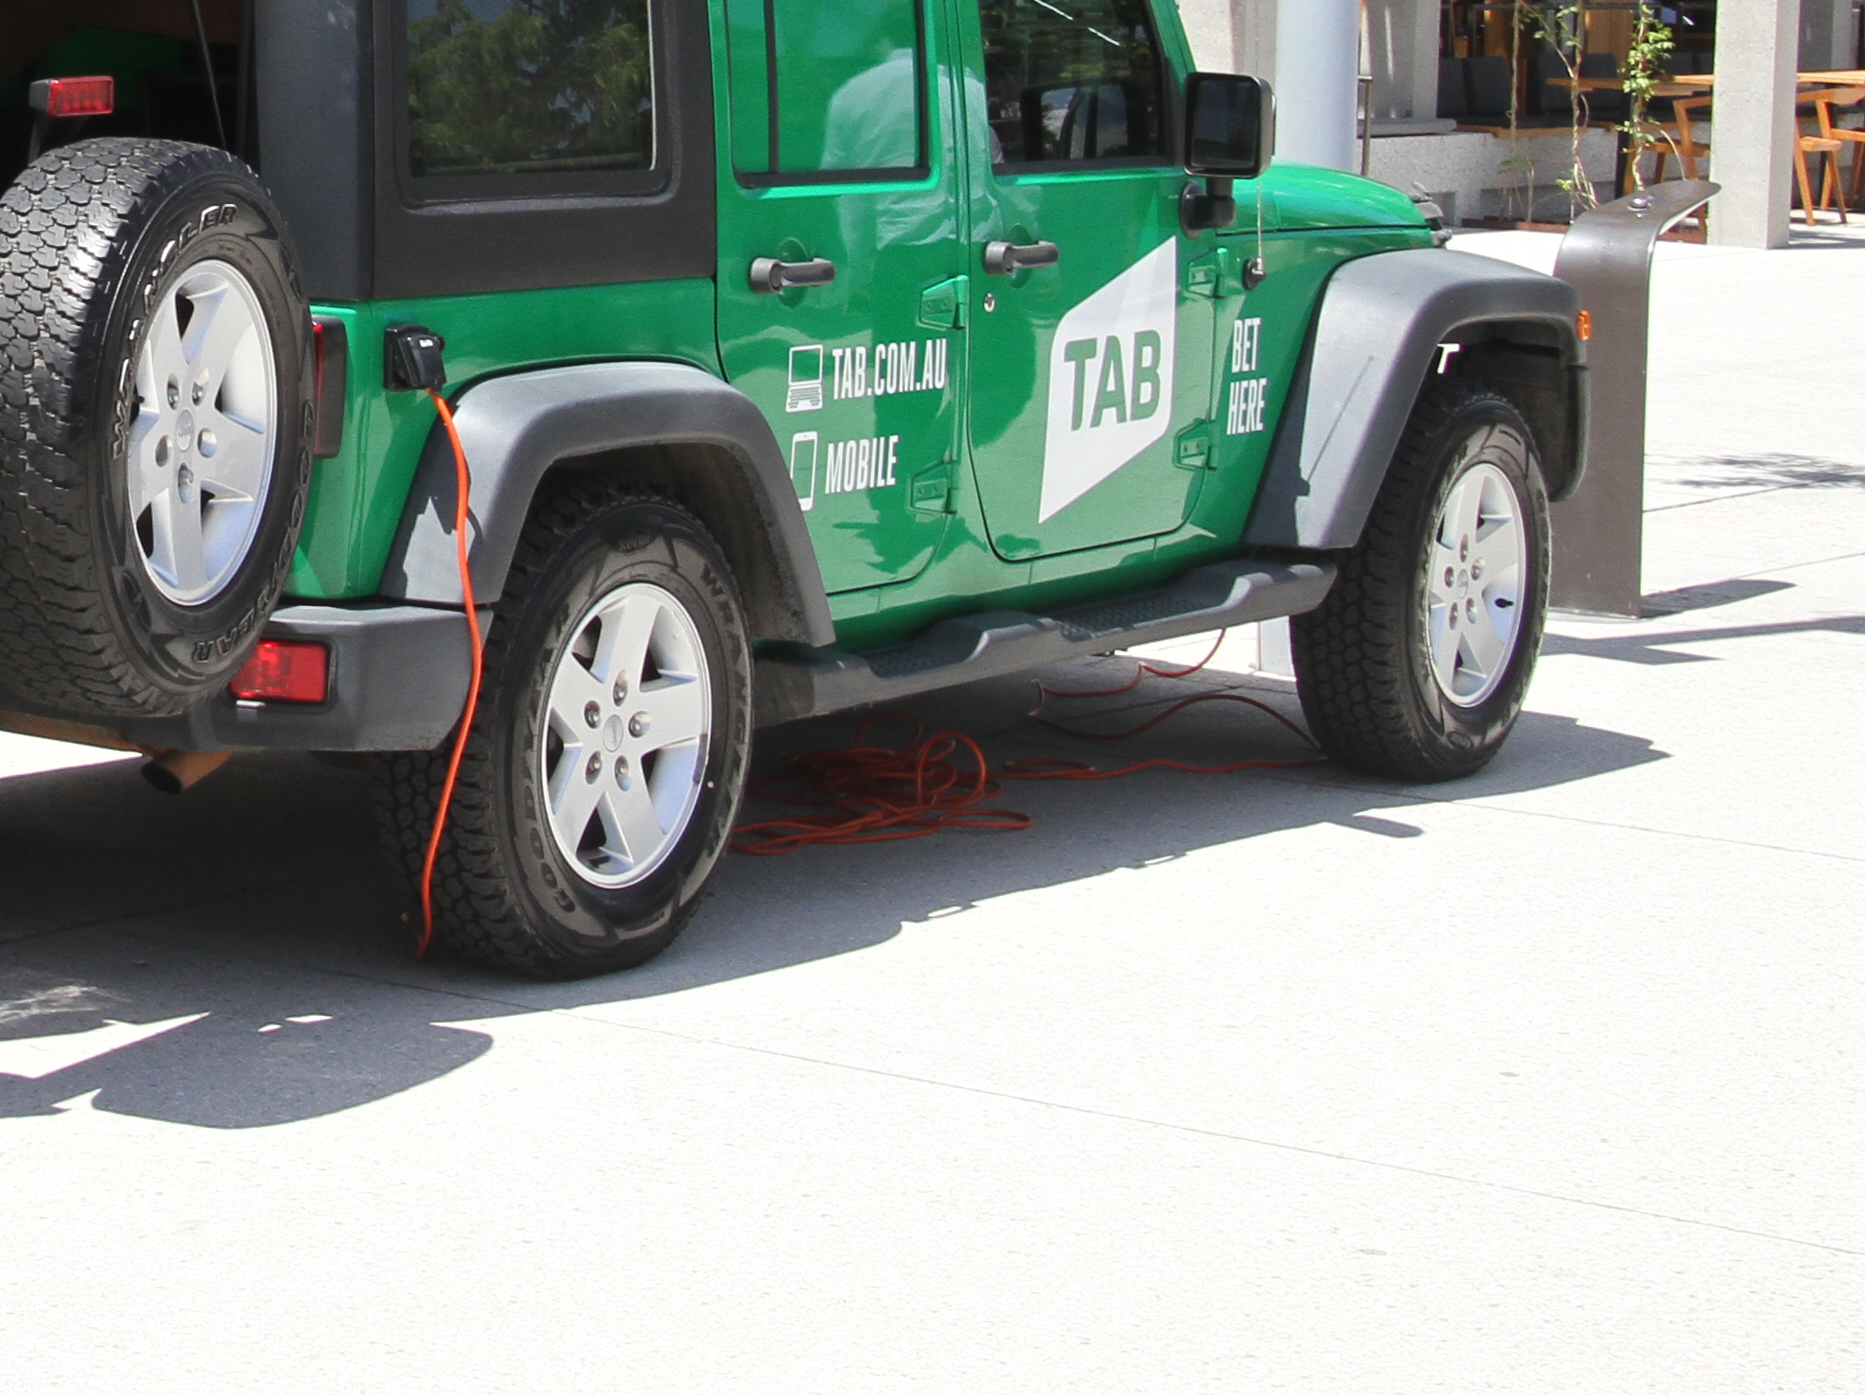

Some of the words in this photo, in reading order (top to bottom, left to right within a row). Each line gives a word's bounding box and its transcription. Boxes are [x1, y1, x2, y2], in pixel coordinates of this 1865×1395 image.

[832, 338, 948, 400] TAB.COM.AU
[1231, 317, 1262, 373] BET
[1063, 329, 1161, 432] TAB
[1227, 378, 1267, 436] HERE
[824, 435, 899, 495] MOBILE
